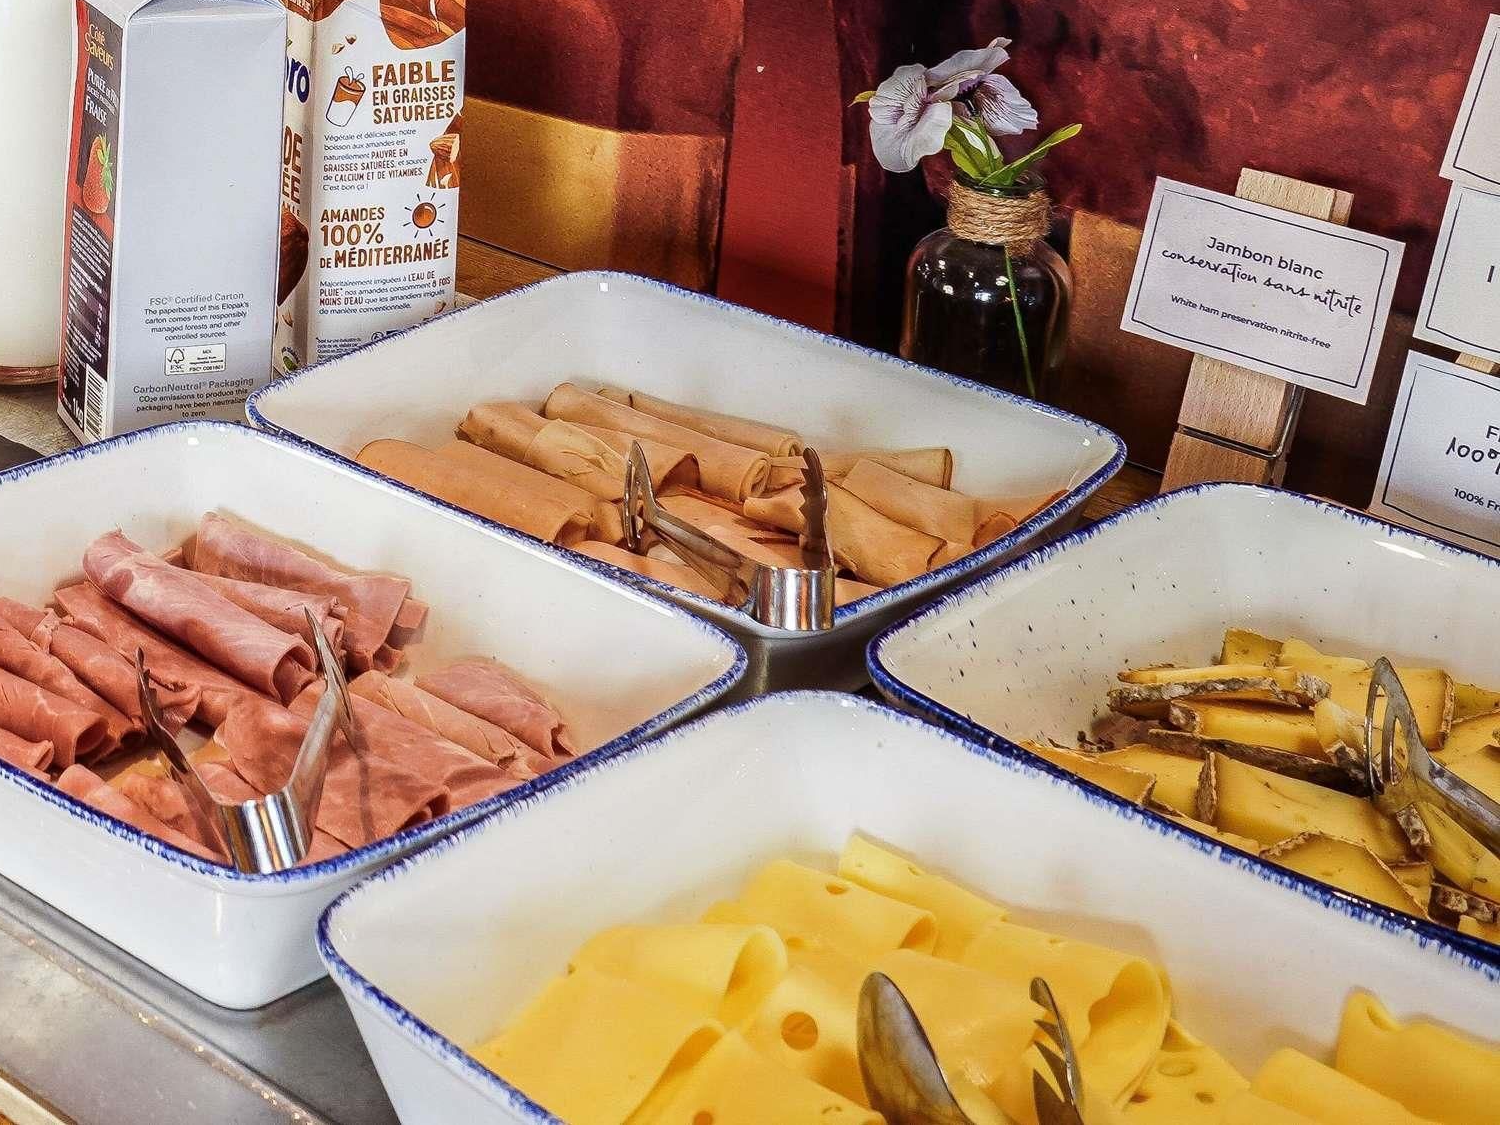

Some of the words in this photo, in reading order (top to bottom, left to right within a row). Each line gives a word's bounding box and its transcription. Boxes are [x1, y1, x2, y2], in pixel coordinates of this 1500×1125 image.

[89, 24, 106, 46] Côté
[84, 32, 115, 71] Saveurs
[287, 57, 311, 104] ro
[372, 60, 456, 88] FAIBLE
[372, 91, 388, 106] EN
[393, 85, 456, 103] GRAISSES
[85, 95, 107, 126] FRAISE
[373, 101, 455, 125] SATURÉES
[324, 143, 351, 151] boisson
[365, 140, 394, 149] amandes
[371, 149, 397, 159] PAUVRE
[399, 148, 408, 157] EN
[324, 163, 358, 172] GRAISSES
[404, 158, 428, 166] source
[334, 172, 364, 182] CALCIUM
[367, 171, 375, 180] ET
[377, 171, 386, 179] DE
[320, 206, 385, 223] AMANDES
[320, 222, 384, 247] 100%
[320, 257, 332, 269] DE
[334, 238, 449, 269] MÉDITERRANÉE
[1206, 236, 1273, 266] Jambon
[1278, 255, 1324, 280] blanc
[408, 271, 425, 282] L'EAU
[427, 270, 435, 280] DE
[1161, 249, 1257, 283] conservation
[1263, 277, 1310, 297] sans
[1313, 288, 1364, 318] nitrite
[358, 287, 388, 295] amandes
[389, 283, 431, 293] consomment
[438, 276, 451, 287] FOIS
[174, 294, 212, 304] Certified
[215, 292, 244, 301] Carton
[319, 297, 342, 306] MOINS
[344, 296, 364, 306] D'EAU
[365, 297, 378, 305] que
[389, 292, 422, 302] amandiers
[159, 305, 197, 315] paperboard
[222, 301, 249, 311] Elopak's
[319, 307, 328, 315] de
[329, 306, 358, 315] manière
[145, 317, 167, 325] carton
[210, 310, 247, 320] responsibly
[1171, 294, 1197, 309] White
[1199, 303, 1220, 316] ham
[1220, 310, 1278, 334] preservation
[1280, 329, 1331, 349] nitrite-free
[151, 324, 183, 334] managed
[185, 322, 207, 331] forests
[209, 321, 222, 329] and
[223, 320, 241, 328] other
[164, 332, 198, 341] controlled
[209, 377, 254, 388] Packaging
[136, 402, 173, 412] packaging
[174, 400, 192, 409] have
[194, 399, 210, 408] been
[212, 396, 246, 406] neutralize
[159, 392, 195, 402] emissions
[196, 391, 204, 400] to
[205, 390, 233, 400] produce
[191, 410, 206, 418] zero
[1454, 487, 1484, 506] 100%
[1486, 499, 1500, 511] Fr
